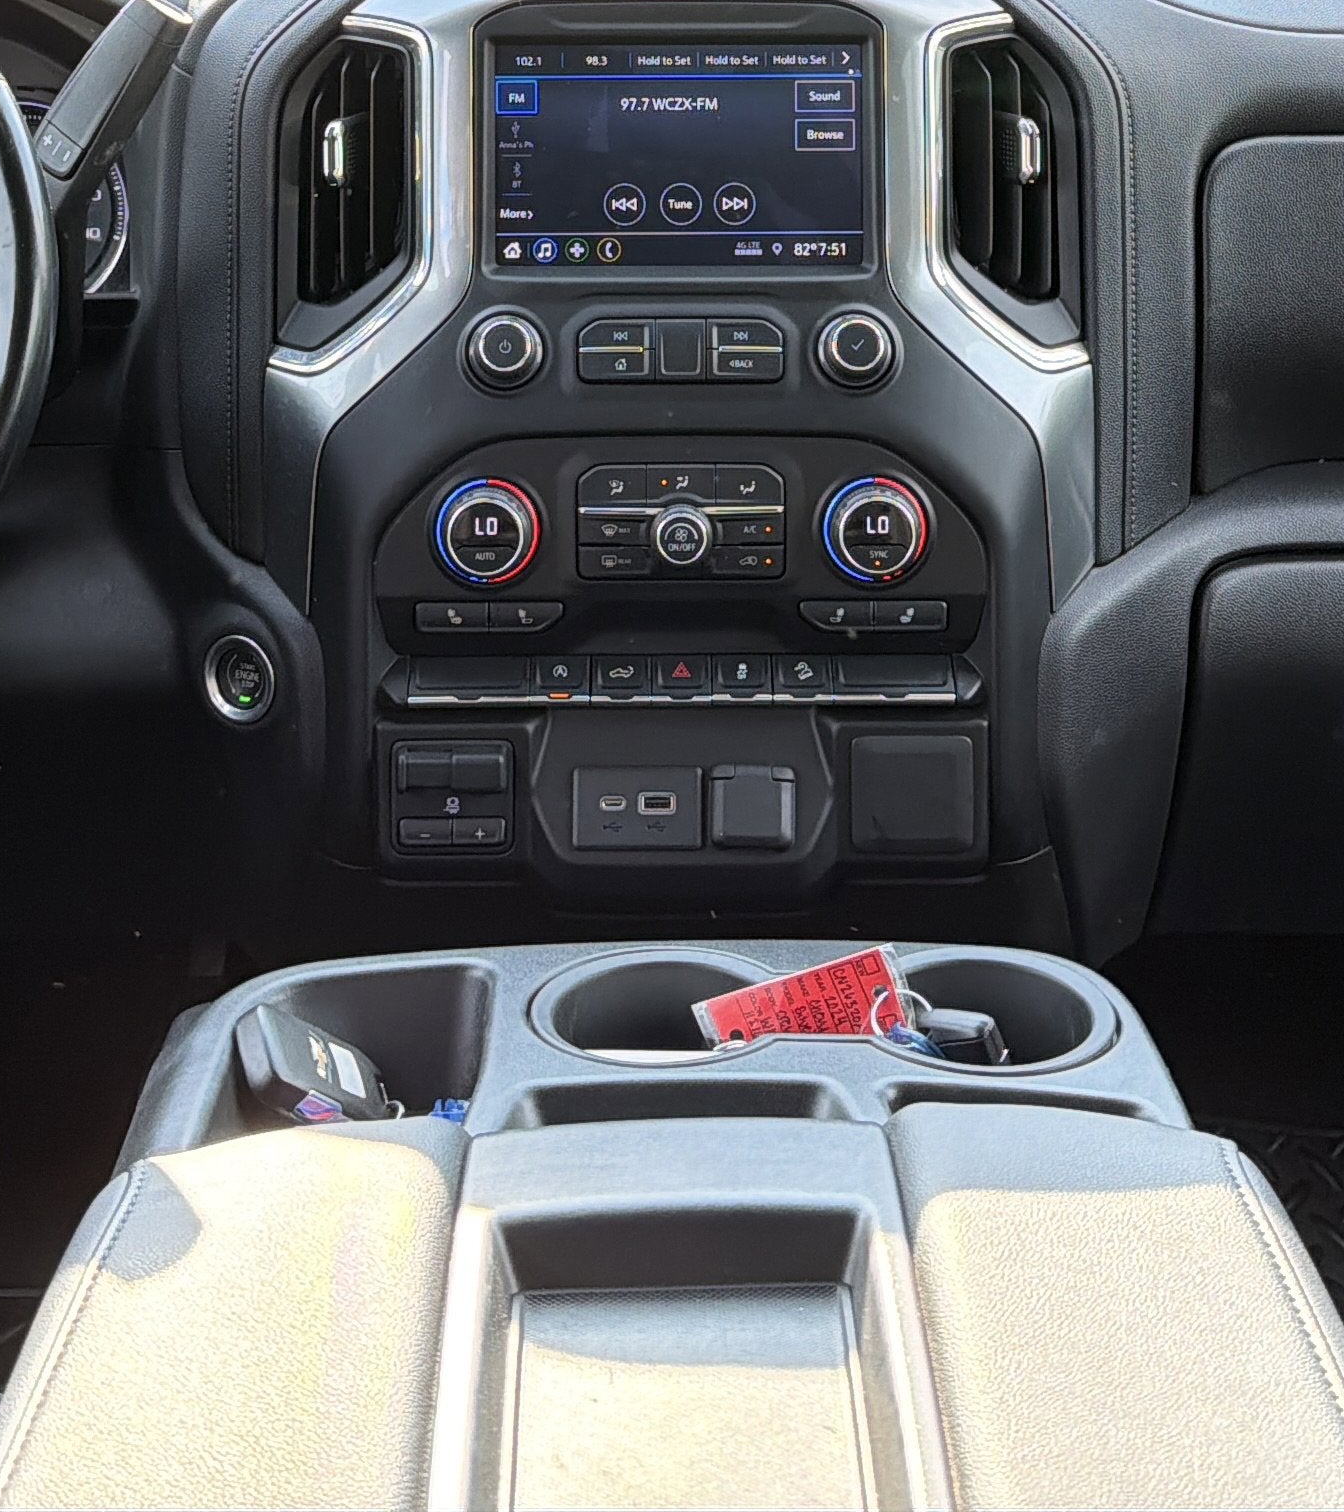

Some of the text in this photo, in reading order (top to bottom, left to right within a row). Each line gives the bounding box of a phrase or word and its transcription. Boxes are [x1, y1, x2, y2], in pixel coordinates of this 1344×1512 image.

[515, 56, 542, 66] 102.1
[585, 55, 608, 66] 98.3
[637, 56, 691, 65] Hold to Set
[705, 56, 759, 65] Hold to Set
[773, 55, 826, 65] Hold to Set
[508, 93, 525, 103] FM
[809, 90, 841, 102] Sound
[620, 98, 718, 111] 97.7 WCZX-FM
[806, 129, 844, 140] Browse
[667, 199, 693, 210] Tune
[500, 209, 526, 219] More
[735, 241, 761, 249] 4G LTE
[735, 359, 753, 368] BACK
[743, 525, 757, 534] A/C
[667, 543, 696, 551] ON/OFF
[474, 552, 496, 560] AUTO
[869, 550, 889, 559] SYNC
[236, 669, 260, 682] ENGINE
